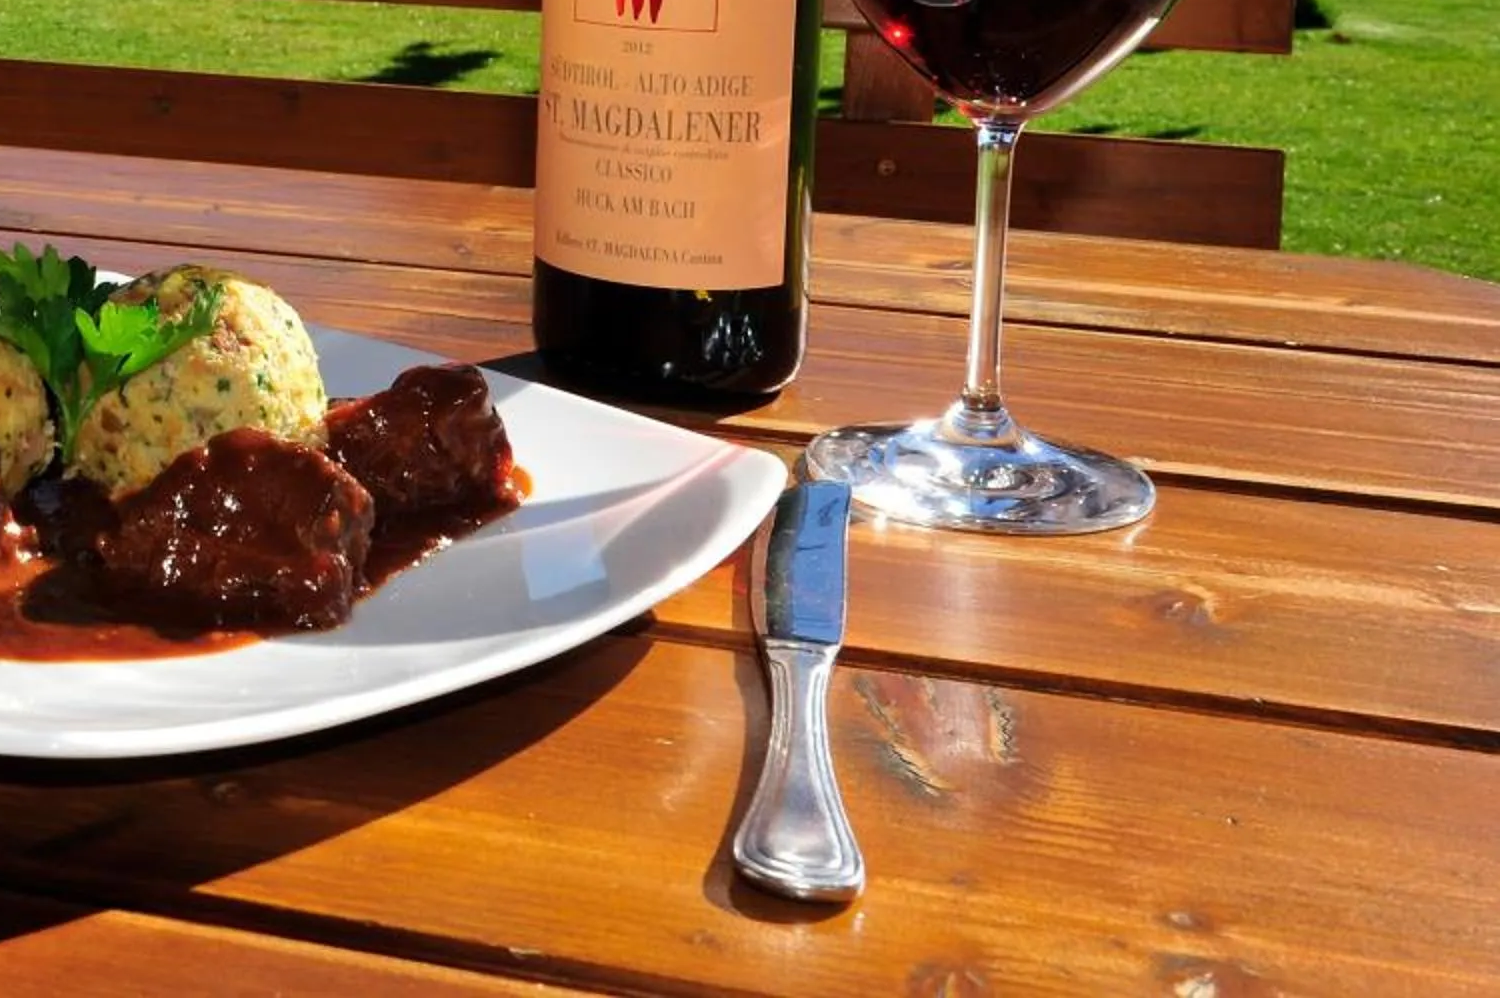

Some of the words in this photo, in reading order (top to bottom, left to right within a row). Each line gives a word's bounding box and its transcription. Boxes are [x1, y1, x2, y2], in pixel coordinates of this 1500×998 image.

[621, 40, 654, 55] 2012
[633, 72, 687, 96] ALTO
[694, 75, 754, 97] ADIGE
[571, 97, 761, 143] MAGDALENER
[595, 157, 672, 183] CLASSICO
[620, 196, 643, 216] AM
[648, 198, 695, 219] BACH
